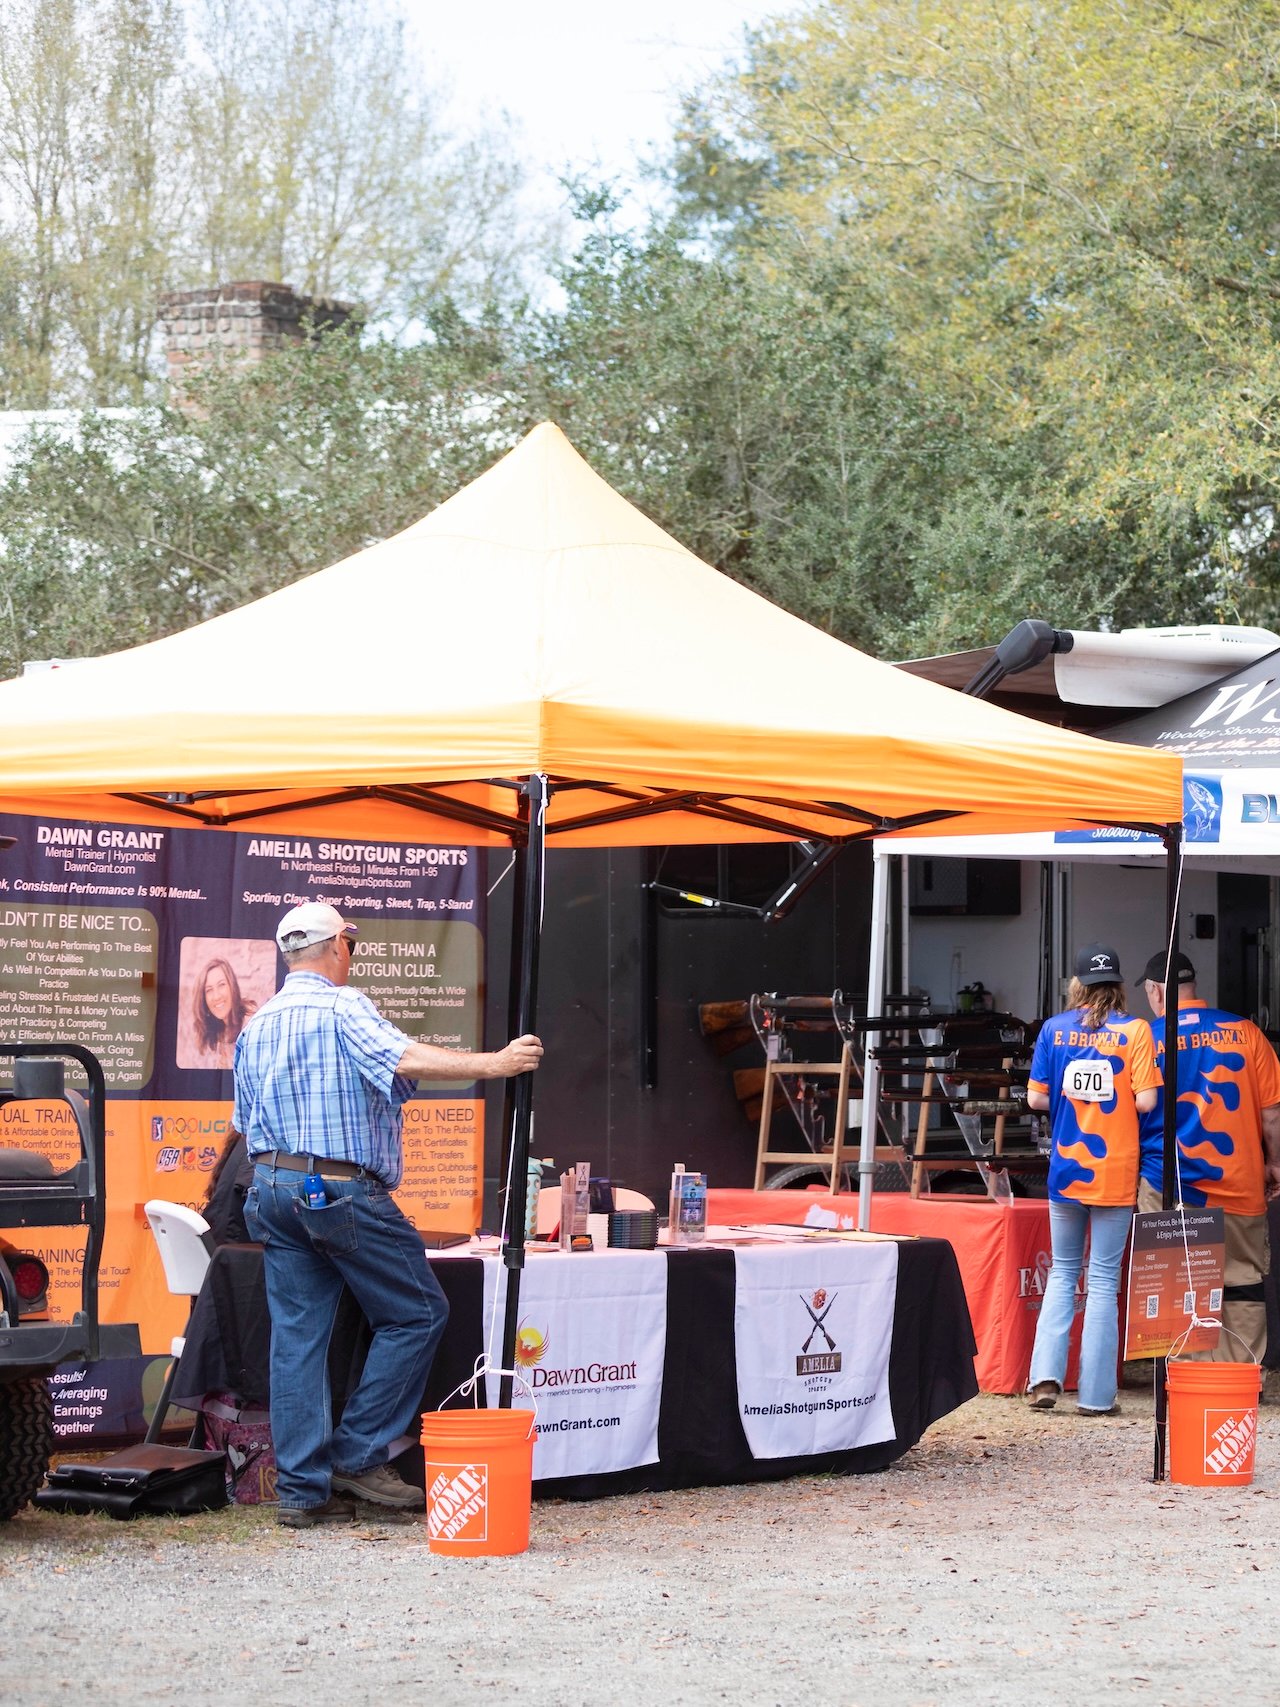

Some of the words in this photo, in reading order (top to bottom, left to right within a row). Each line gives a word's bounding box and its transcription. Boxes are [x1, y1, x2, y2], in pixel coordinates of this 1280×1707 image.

[1157, 730, 1220, 740] Woolley
[37, 826, 92, 846] DAWN
[97, 830, 164, 850] GRANT
[45, 847, 74, 858] Mental
[76, 848, 105, 860] Trainer
[113, 850, 156, 863] Hypnotist
[247, 840, 312, 859] AMELIA
[318, 843, 400, 864] SHOTGUN
[405, 848, 468, 866] SPORTS
[64, 861, 136, 874] DawnGrant.com
[281, 860, 290, 870] In
[291, 860, 334, 872] Northeast
[334, 862, 360, 874] Florida
[367, 864, 398, 876] Minutes
[400, 866, 419, 876] From
[422, 866, 438, 877] I-95
[308, 874, 411, 889] AmeliaShotgunSports.com
[14, 878, 67, 893] Consistent
[69, 882, 134, 896] Performance
[137, 885, 148, 896] Is
[149, 886, 167, 898] 90%
[168, 888, 207, 900] Mental...
[242, 891, 281, 906] Sporting
[316, 894, 342, 906] Super
[344, 896, 384, 910] Sporting,
[386, 898, 414, 910] Skeet,
[416, 898, 437, 911] Trap,
[439, 900, 474, 910] 5-Stand
[42, 913, 56, 928] IT
[59, 914, 77, 928] BE
[81, 915, 114, 930] NICE
[119, 916, 151, 932] TO...
[10, 938, 28, 948] Feel
[30, 939, 44, 949] You
[46, 940, 59, 950] Are
[60, 941, 100, 953] Performing
[102, 942, 112, 951] To
[115, 942, 132, 952] The
[134, 942, 152, 953] Best
[391, 943, 425, 956] THAN
[428, 944, 436, 957] A
[26, 952, 36, 962] Of
[38, 953, 56, 962] Your
[56, 954, 84, 964] Abilities
[2, 964, 14, 974] As
[16, 965, 34, 974] Well
[44, 966, 87, 978] Competition
[88, 968, 99, 977] As
[100, 968, 116, 977] You
[119, 968, 132, 978] Do
[134, 968, 144, 978] In
[348, 963, 402, 977] HOTGUN
[404, 964, 442, 978] CLUB...
[39, 978, 70, 989] Practice
[18, 991, 53, 1002] Stressed
[62, 992, 98, 1002] Frustrated
[112, 994, 142, 1004] Events
[445, 986, 466, 996] Wide
[12, 1004, 36, 1014] About
[37, 1004, 52, 1014] The
[54, 1005, 72, 1015] Time
[82, 1006, 108, 1018] Money
[110, 1006, 139, 1016] You've
[20, 1018, 58, 1029] Practicing
[66, 1019, 107, 1030] Competing
[18, 1030, 55, 1042] Efficiently
[56, 1031, 76, 1041] Move
[78, 1032, 90, 1041] On
[92, 1032, 114, 1042] From
[115, 1032, 122, 1042] A
[124, 1032, 145, 1042] Miss
[433, 1034, 461, 1044] Special
[1054, 1030, 1066, 1046] E.
[1068, 1030, 1122, 1048] BROWN
[1191, 1030, 1247, 1049] BROWN
[108, 1044, 134, 1056] Going
[116, 1058, 143, 1068] Game
[117, 1070, 142, 1082] Again
[1074, 1072, 1102, 1091] 670
[402, 1108, 431, 1122] YOU
[436, 1108, 474, 1122] NEED
[12, 1127, 49, 1136] Affordable
[50, 1128, 74, 1136] Online
[454, 1126, 477, 1134] Public
[22, 1140, 52, 1149] Comfort
[424, 1138, 468, 1147] Certificates
[410, 1151, 427, 1160] FFL
[429, 1150, 464, 1159] Transfers
[437, 1164, 478, 1172] Clubhouse
[440, 1176, 456, 1184] Pole
[458, 1176, 478, 1184] Barn
[396, 1189, 438, 1198] Overnights
[449, 1188, 478, 1198] Vintage
[1158, 1219, 1171, 1228] Focus,
[1190, 1216, 1214, 1224] Consistent,
[54, 1280, 81, 1288] School
[802, 1356, 836, 1374] AMELIA
[532, 1360, 636, 1388] DawnGrant
[56, 1388, 108, 1401] Averaging
[546, 1389, 570, 1397] mental
[571, 1386, 600, 1396] training
[606, 1384, 636, 1393] hypnosis
[54, 1404, 103, 1418] Earnings
[534, 1416, 620, 1434] awnGrant.com
[1212, 1416, 1238, 1442] THE
[1206, 1409, 1256, 1474] HOME
[429, 1472, 450, 1500] THE
[428, 1464, 486, 1538] HOME
[442, 1492, 486, 1540] DEPOT
